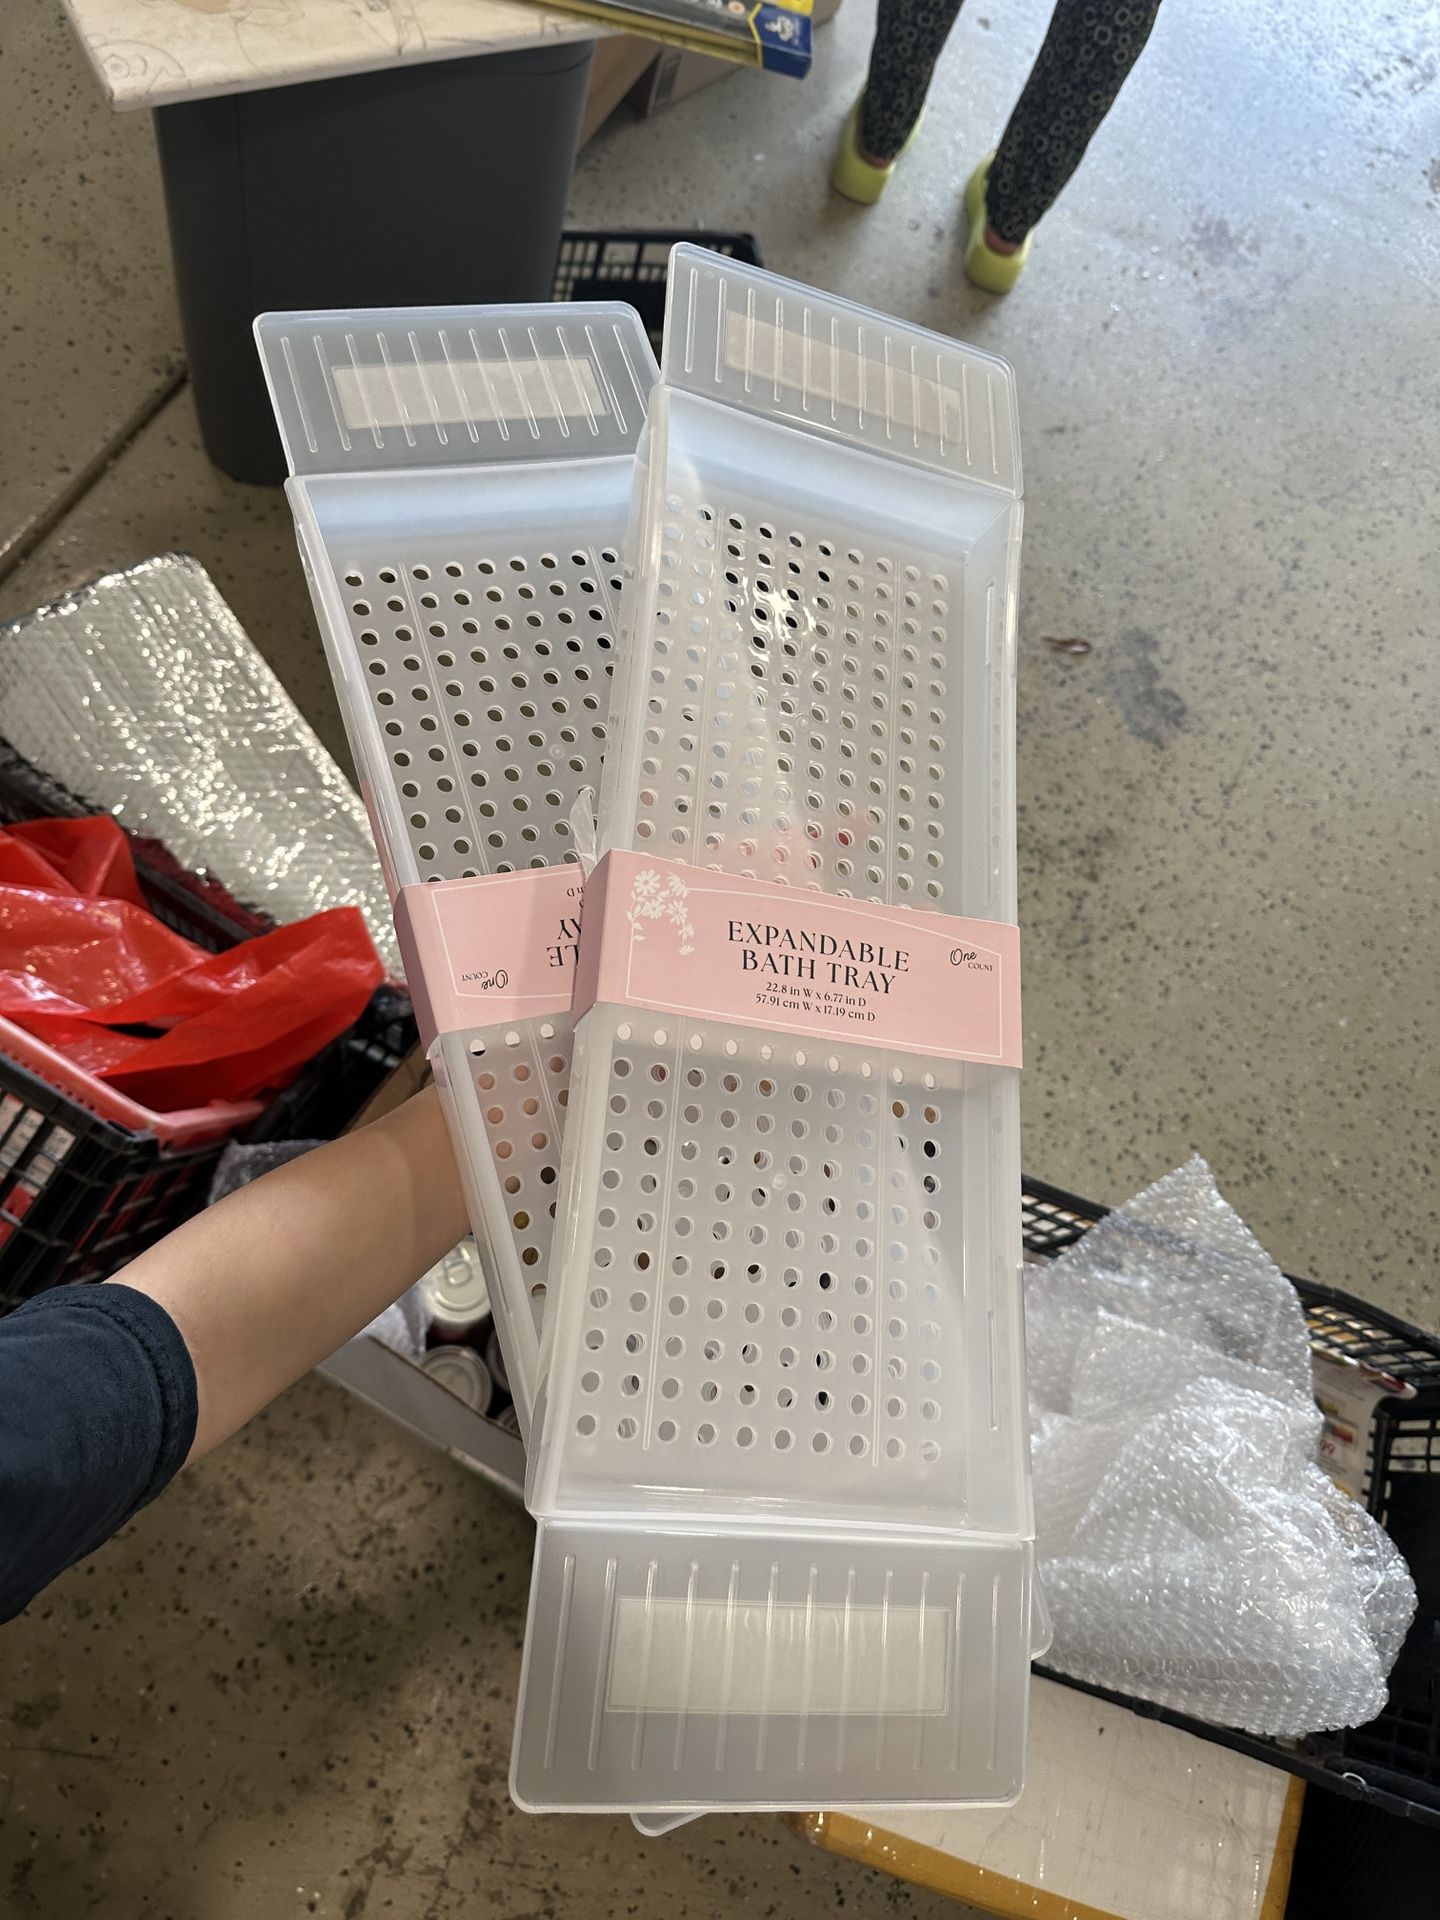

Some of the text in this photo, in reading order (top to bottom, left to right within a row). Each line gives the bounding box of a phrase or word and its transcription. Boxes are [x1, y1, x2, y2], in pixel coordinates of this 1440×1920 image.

[728, 920, 910, 972] EXPANDABLE
[949, 948, 977, 966] One
[461, 971, 489, 982] COUNT
[742, 949, 896, 994] BATH TRAY
[967, 962, 993, 971] COUNT
[480, 969, 509, 990] One
[766, 981, 867, 1007] 22.8 in W x 6.77 in D
[755, 993, 876, 1022] 57.91 cm W x 17.19 cm D
